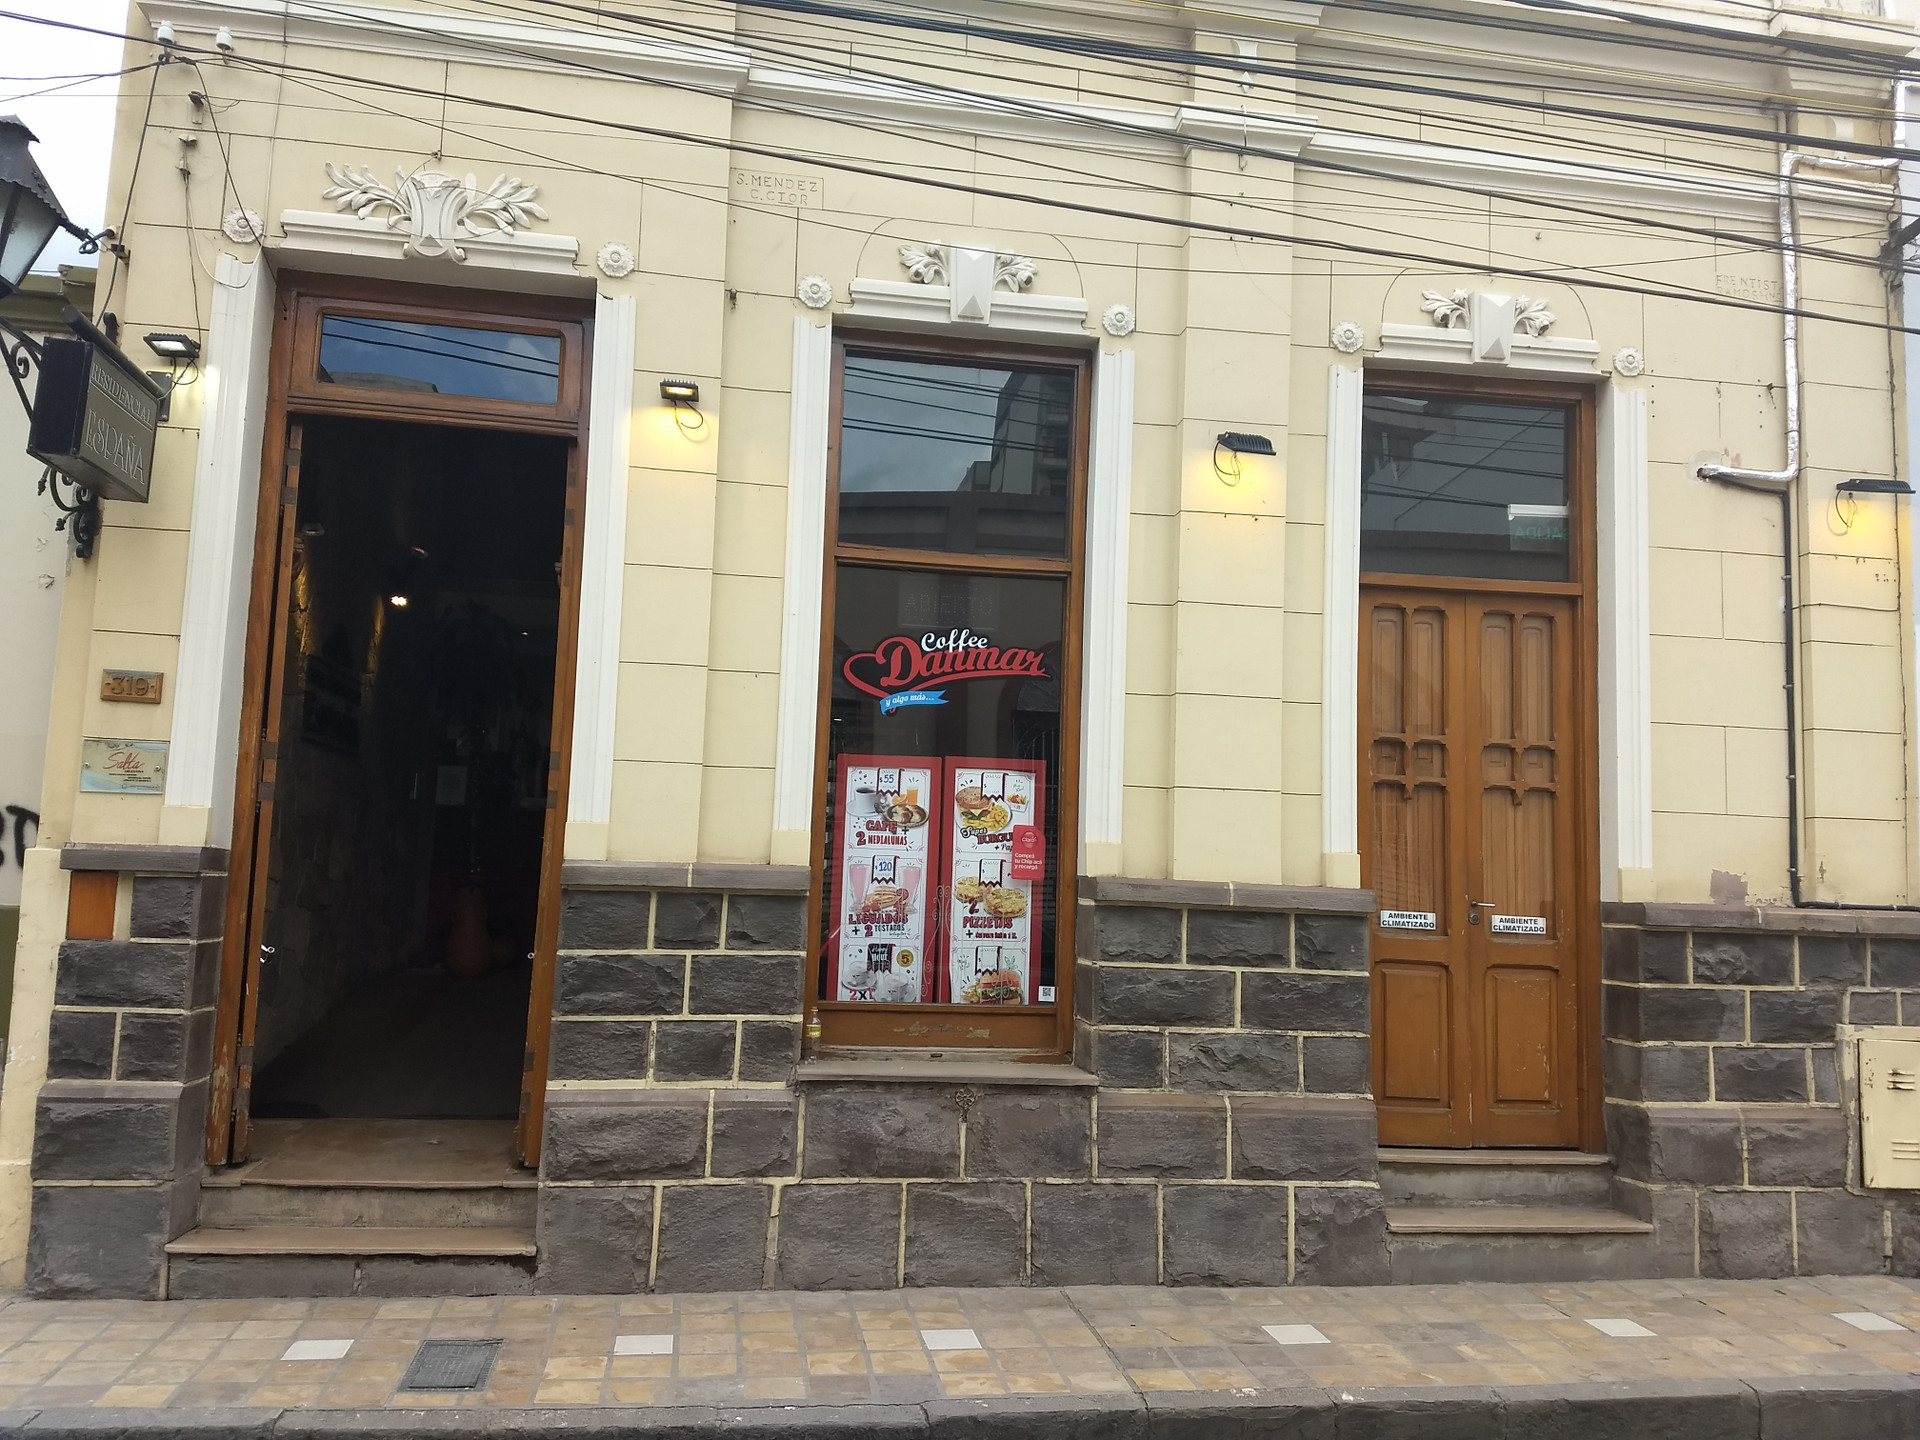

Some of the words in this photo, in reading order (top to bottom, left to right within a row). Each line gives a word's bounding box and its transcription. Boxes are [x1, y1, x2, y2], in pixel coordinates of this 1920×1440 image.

[1715, 274, 1783, 291] FRENTIST
[91, 363, 152, 423] RESIDENCIAL
[84, 407, 145, 486] ESPAÑA
[920, 628, 988, 653] Coffee
[869, 636, 1049, 688] Danmar
[885, 698, 891, 707] y
[892, 694, 910, 705] algo
[102, 752, 145, 770] Salta
[855, 831, 866, 846] 2
[962, 916, 1014, 929] PIZZETAS
[1388, 912, 1429, 920] AMBIENTE
[1498, 917, 1539, 925] AMBIENTE
[864, 925, 873, 937] 2
[874, 924, 906, 932] TOSTADOS
[1381, 919, 1435, 929] CLIMATIZADO
[1493, 924, 1545, 933] CLIMATIZADO
[901, 954, 910, 965] 5
